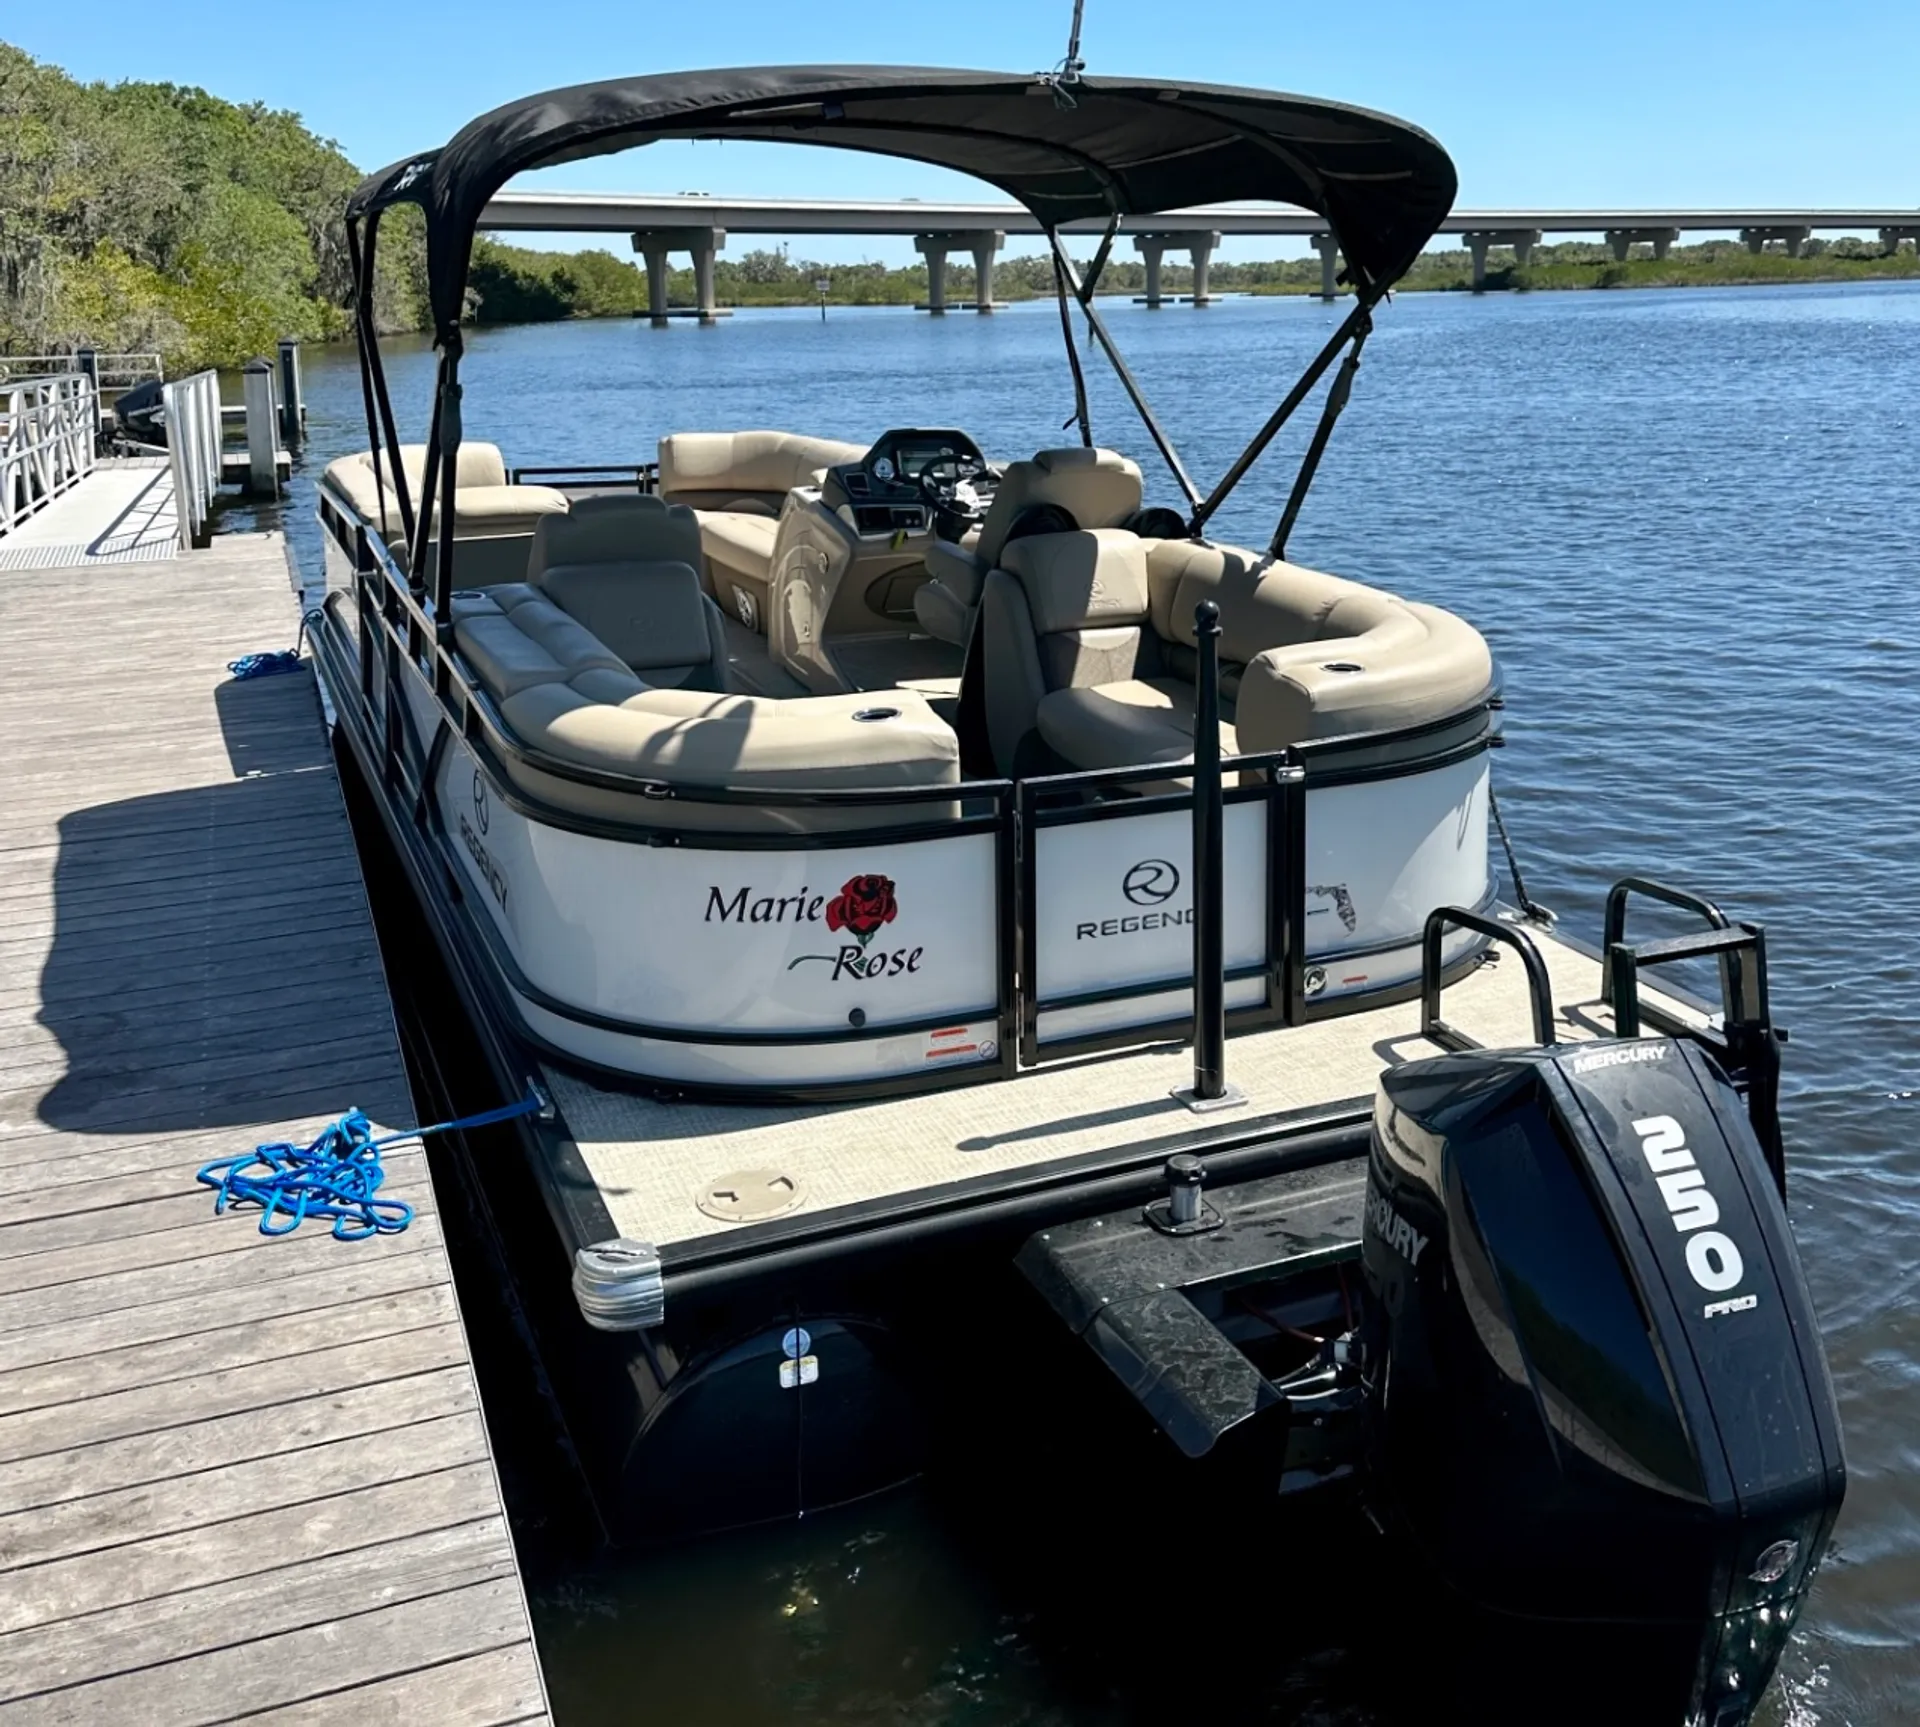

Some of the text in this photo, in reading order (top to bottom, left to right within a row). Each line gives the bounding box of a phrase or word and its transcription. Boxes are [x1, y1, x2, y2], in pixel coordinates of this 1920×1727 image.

[704, 886, 824, 924] Marie
[1076, 908, 1195, 941] REGENC
[831, 944, 924, 981] Rose
[1573, 1046, 1667, 1074] MERCURY
[1631, 1114, 1744, 1292] 250
